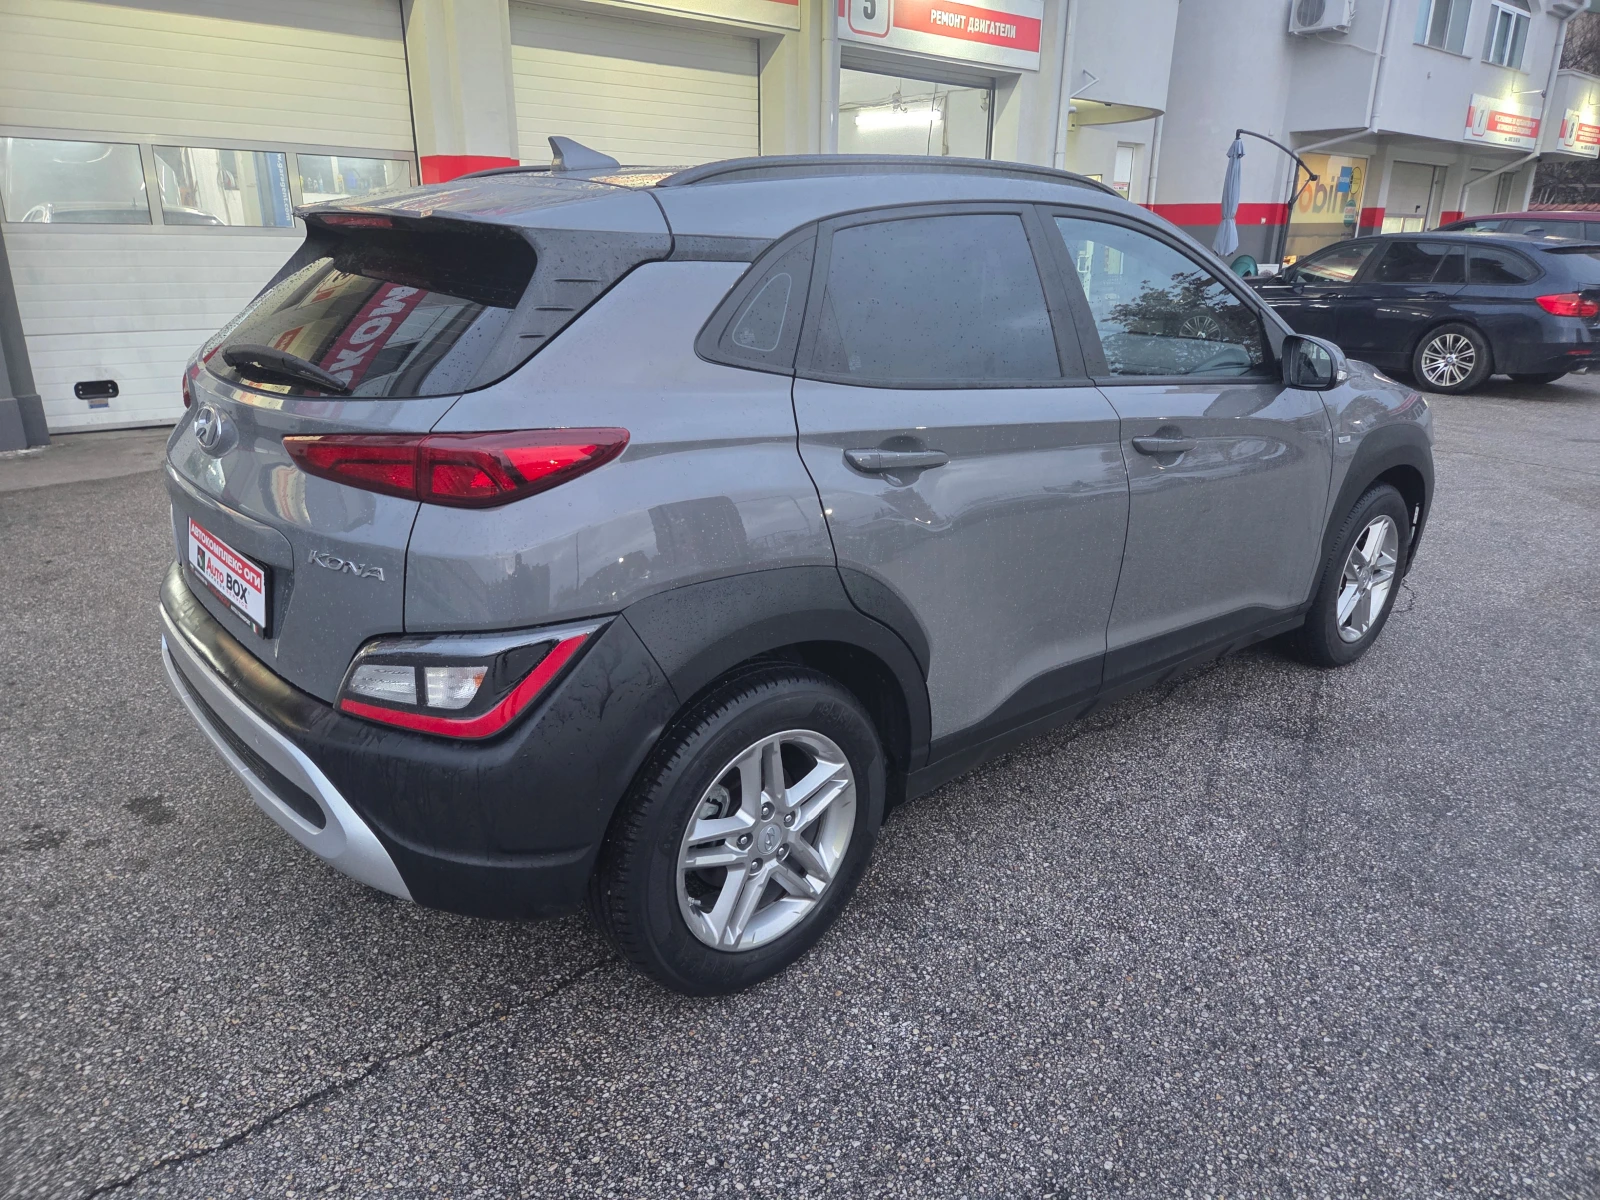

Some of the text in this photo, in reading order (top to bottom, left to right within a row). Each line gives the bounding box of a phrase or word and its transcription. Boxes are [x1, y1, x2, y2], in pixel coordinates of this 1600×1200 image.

[930, 9, 1016, 39] РЕМОНТ ДВИГАТЕЛИ
[1292, 175, 1340, 214] obil
[191, 523, 243, 574] АВТОКОМПЛЕКС
[243, 567, 261, 589] ОГИ
[307, 549, 385, 581] KONA
[226, 572, 248, 604] BOX
